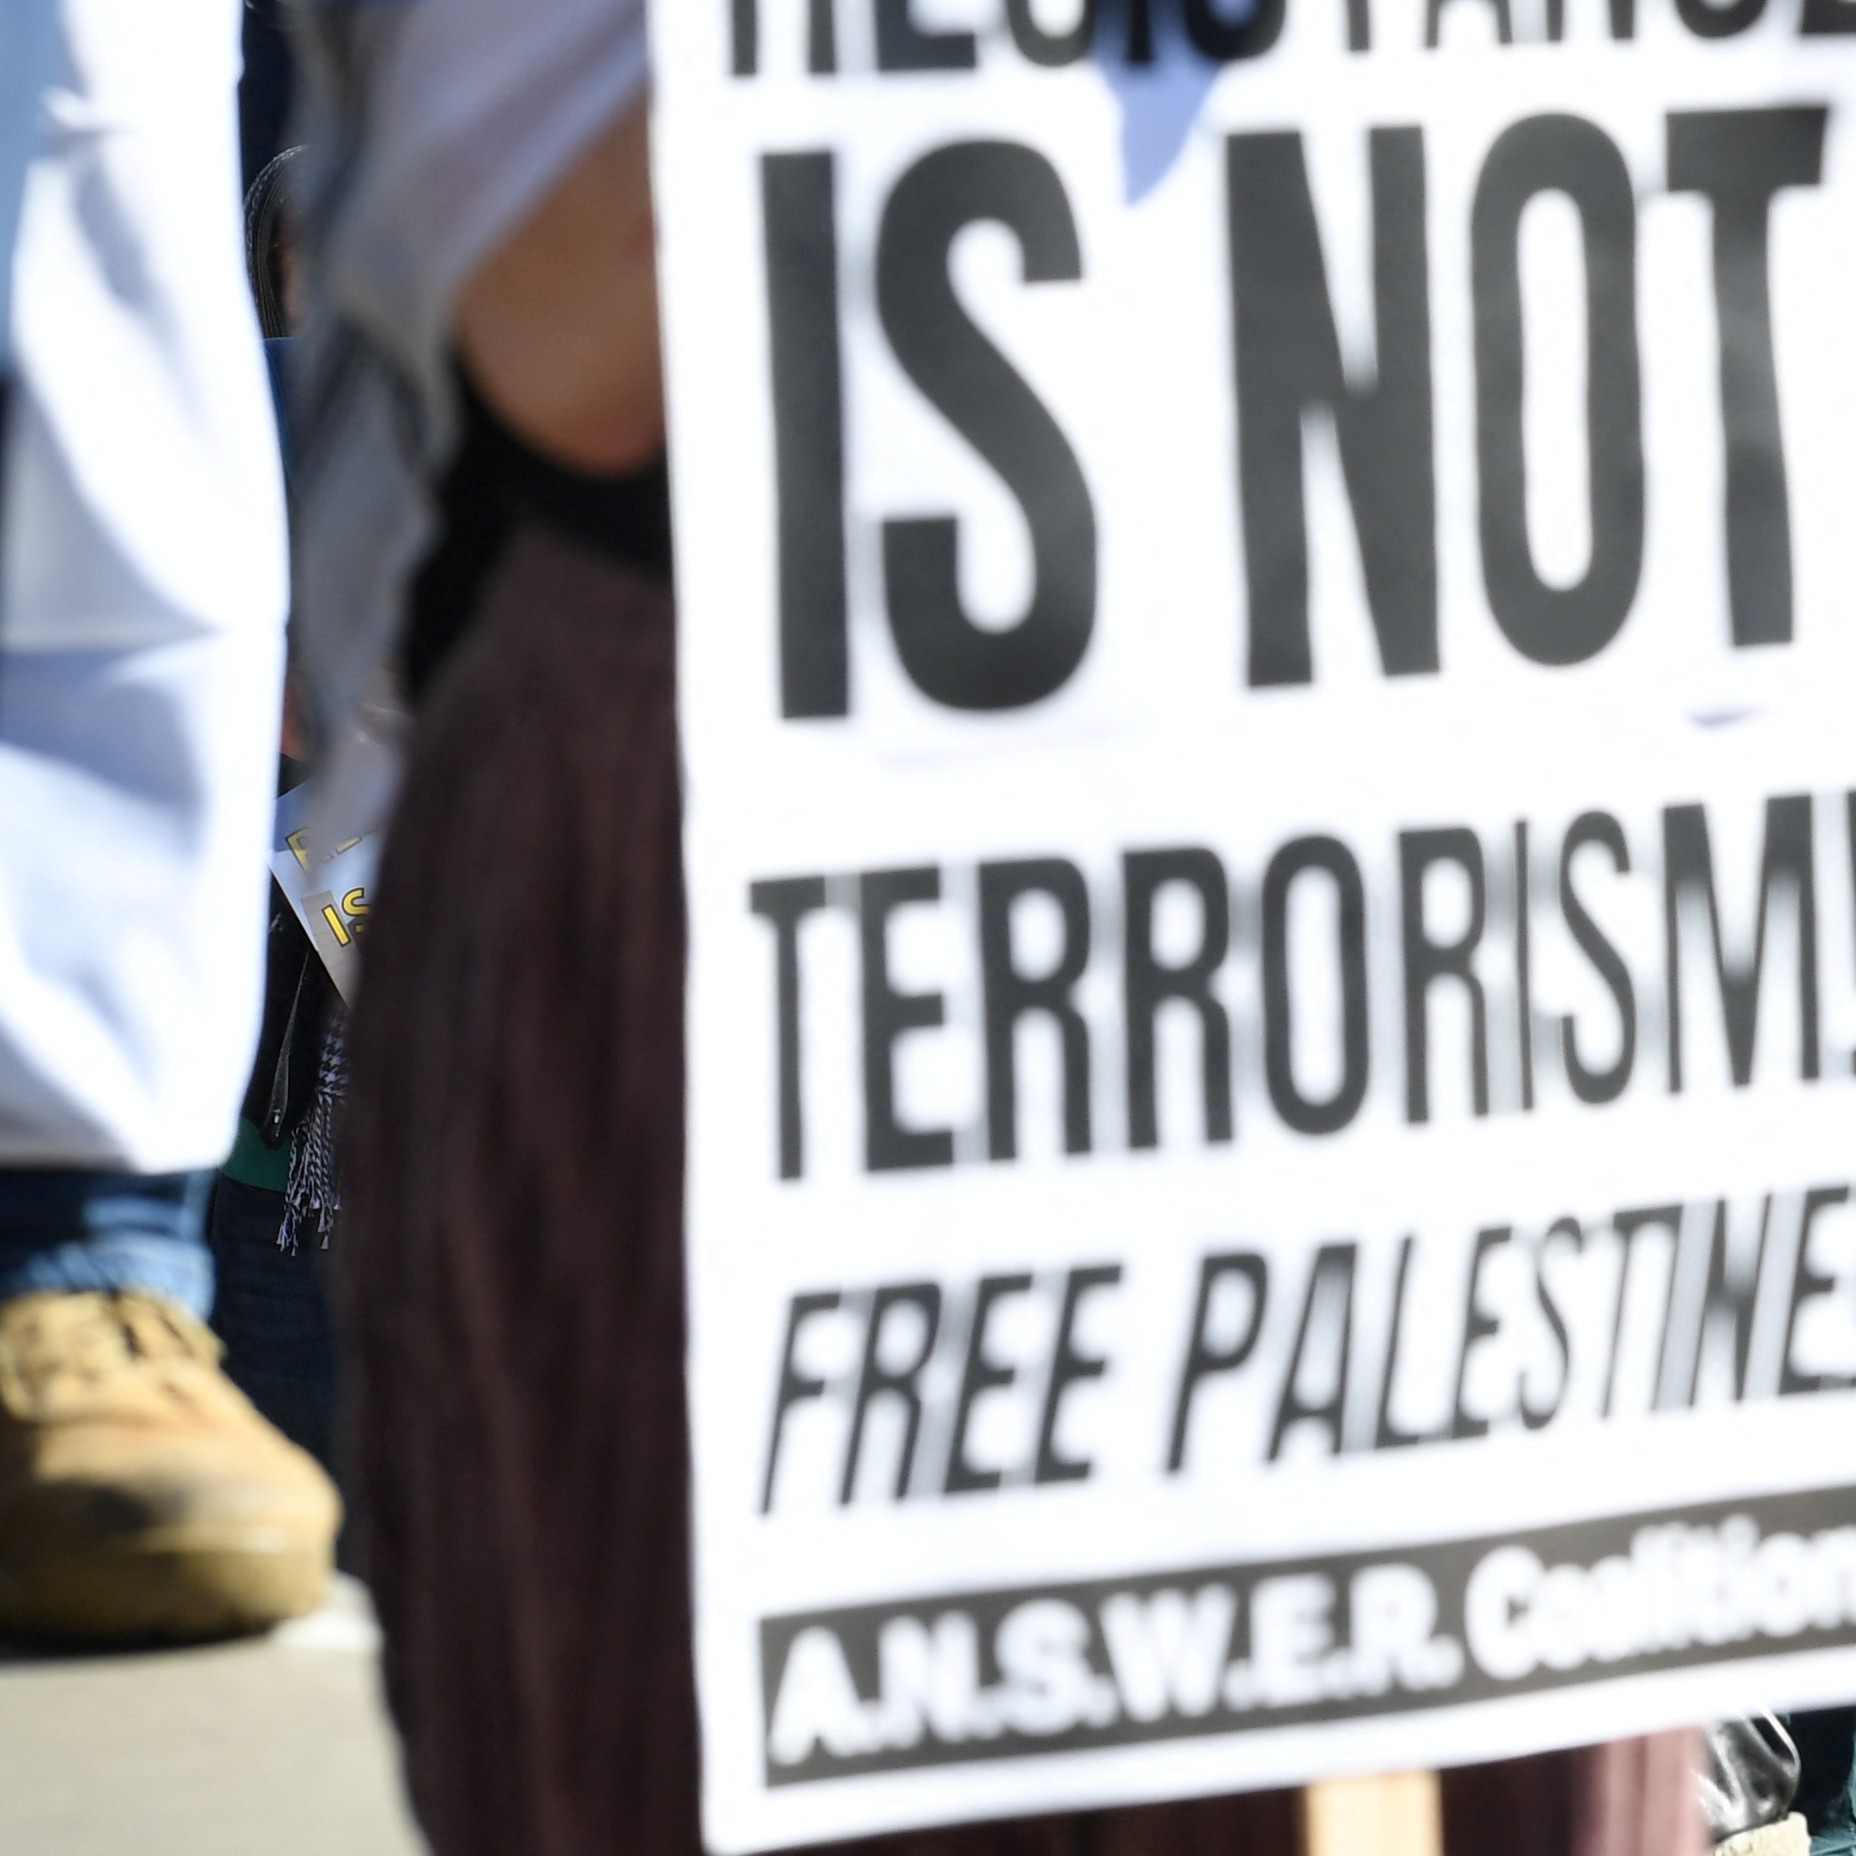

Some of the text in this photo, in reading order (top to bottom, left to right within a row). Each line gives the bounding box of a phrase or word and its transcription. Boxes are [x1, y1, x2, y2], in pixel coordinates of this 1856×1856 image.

[760, 104, 1832, 721] IS NOT
[761, 1257, 1126, 1519] FREE
[768, 1564, 1458, 1766] A.N.S.W.E.R.
